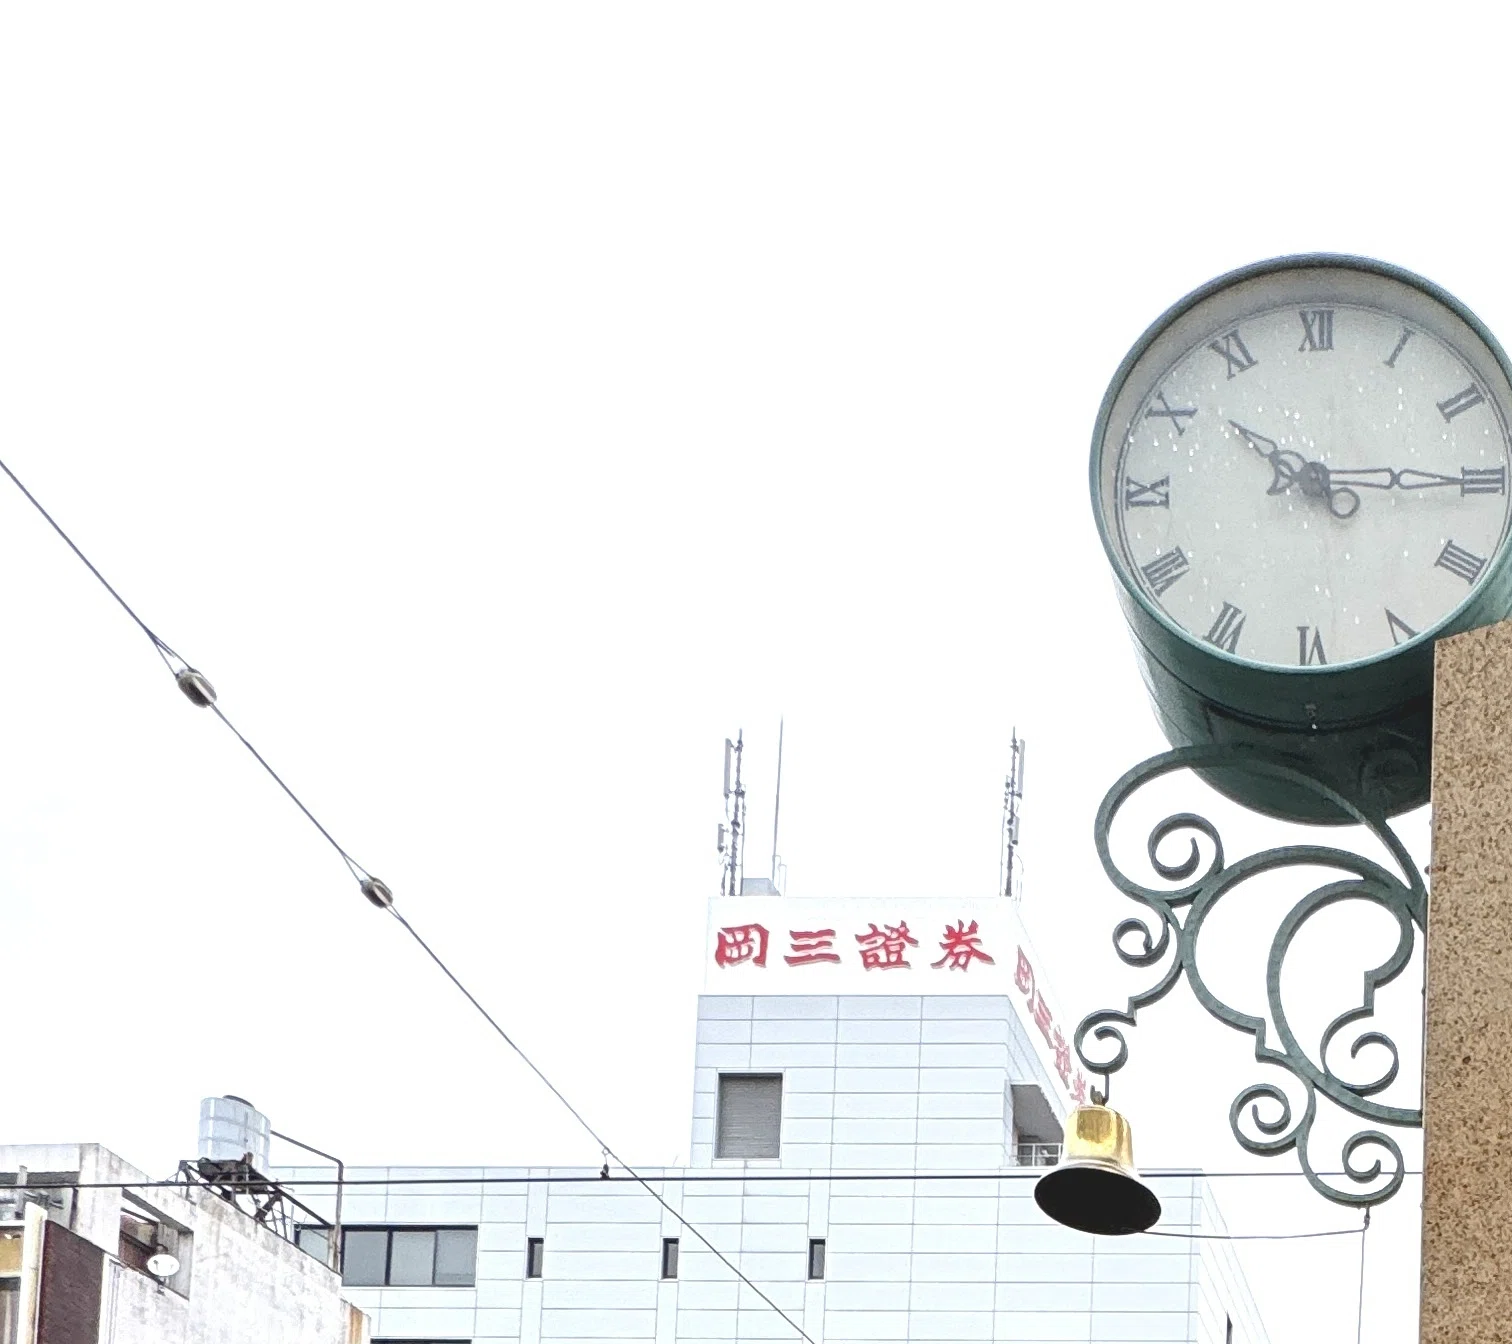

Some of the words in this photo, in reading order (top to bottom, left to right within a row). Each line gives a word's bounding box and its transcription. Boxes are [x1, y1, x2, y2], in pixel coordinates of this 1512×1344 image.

[1298, 309, 1335, 352] XII
[1383, 327, 1415, 369] I
[1207, 329, 1258, 380] XI
[1145, 391, 1198, 436] X
[1436, 382, 1487, 424] II
[1125, 475, 1171, 510] IX
[1460, 465, 1505, 497] III
